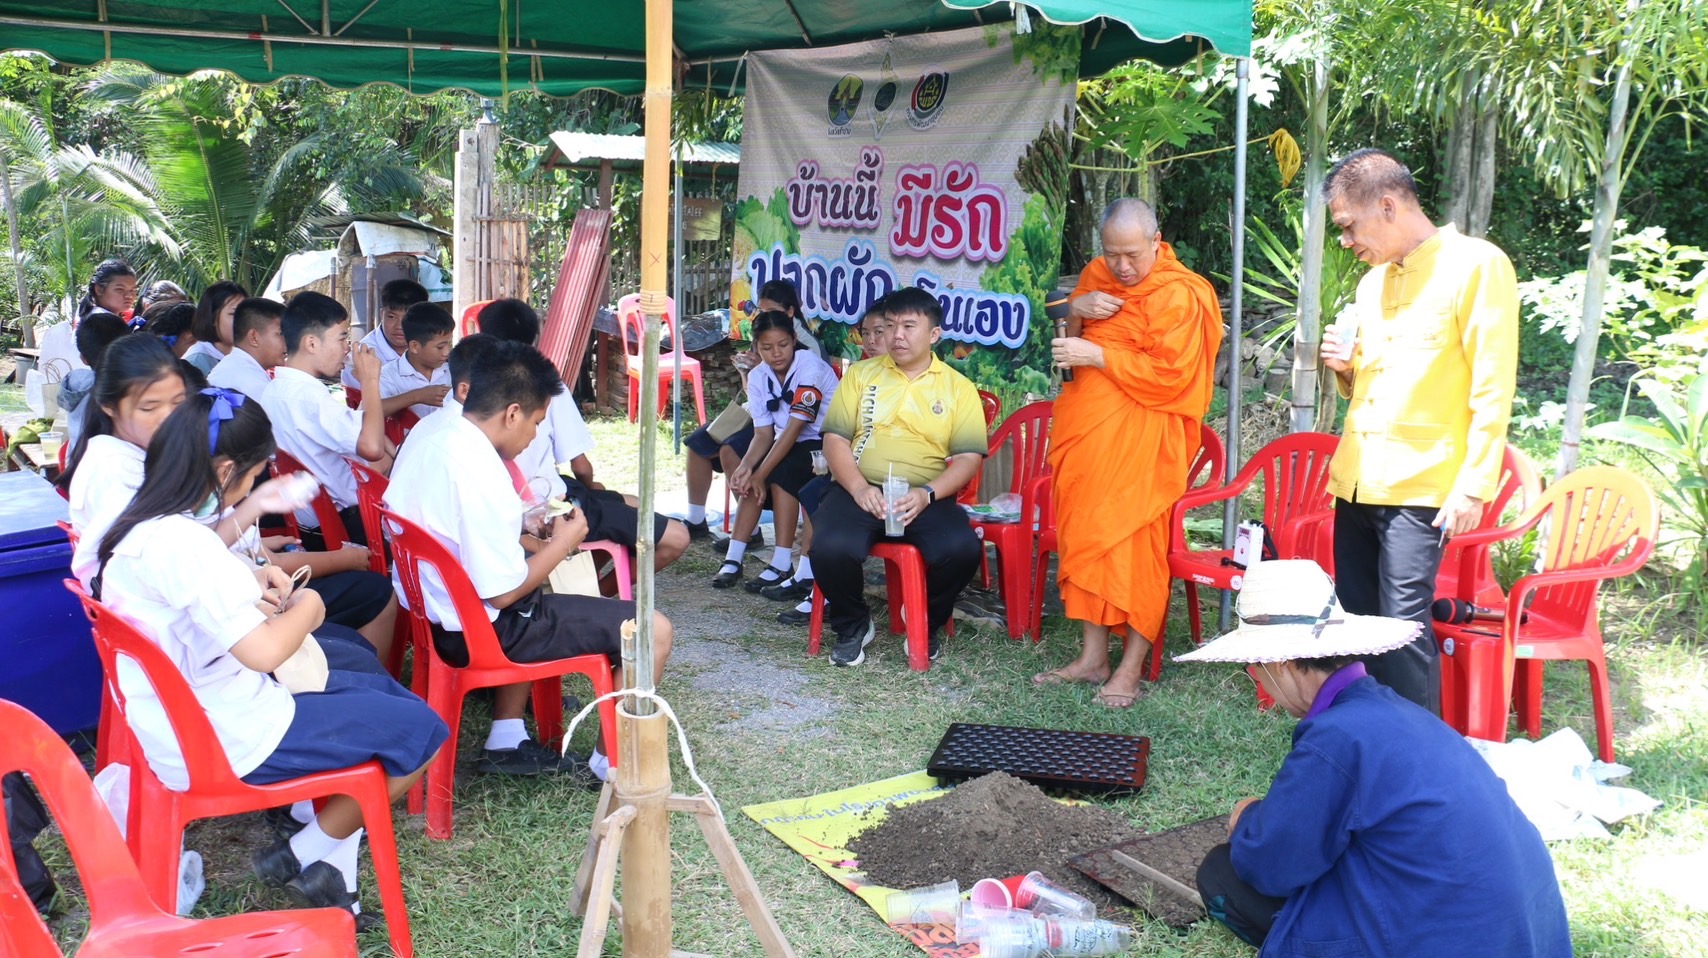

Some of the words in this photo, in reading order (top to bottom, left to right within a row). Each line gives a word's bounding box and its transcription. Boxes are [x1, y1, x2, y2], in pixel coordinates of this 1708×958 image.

[789, 152, 878, 221] บ้านนี้
[893, 169, 1003, 252] มีรัก
